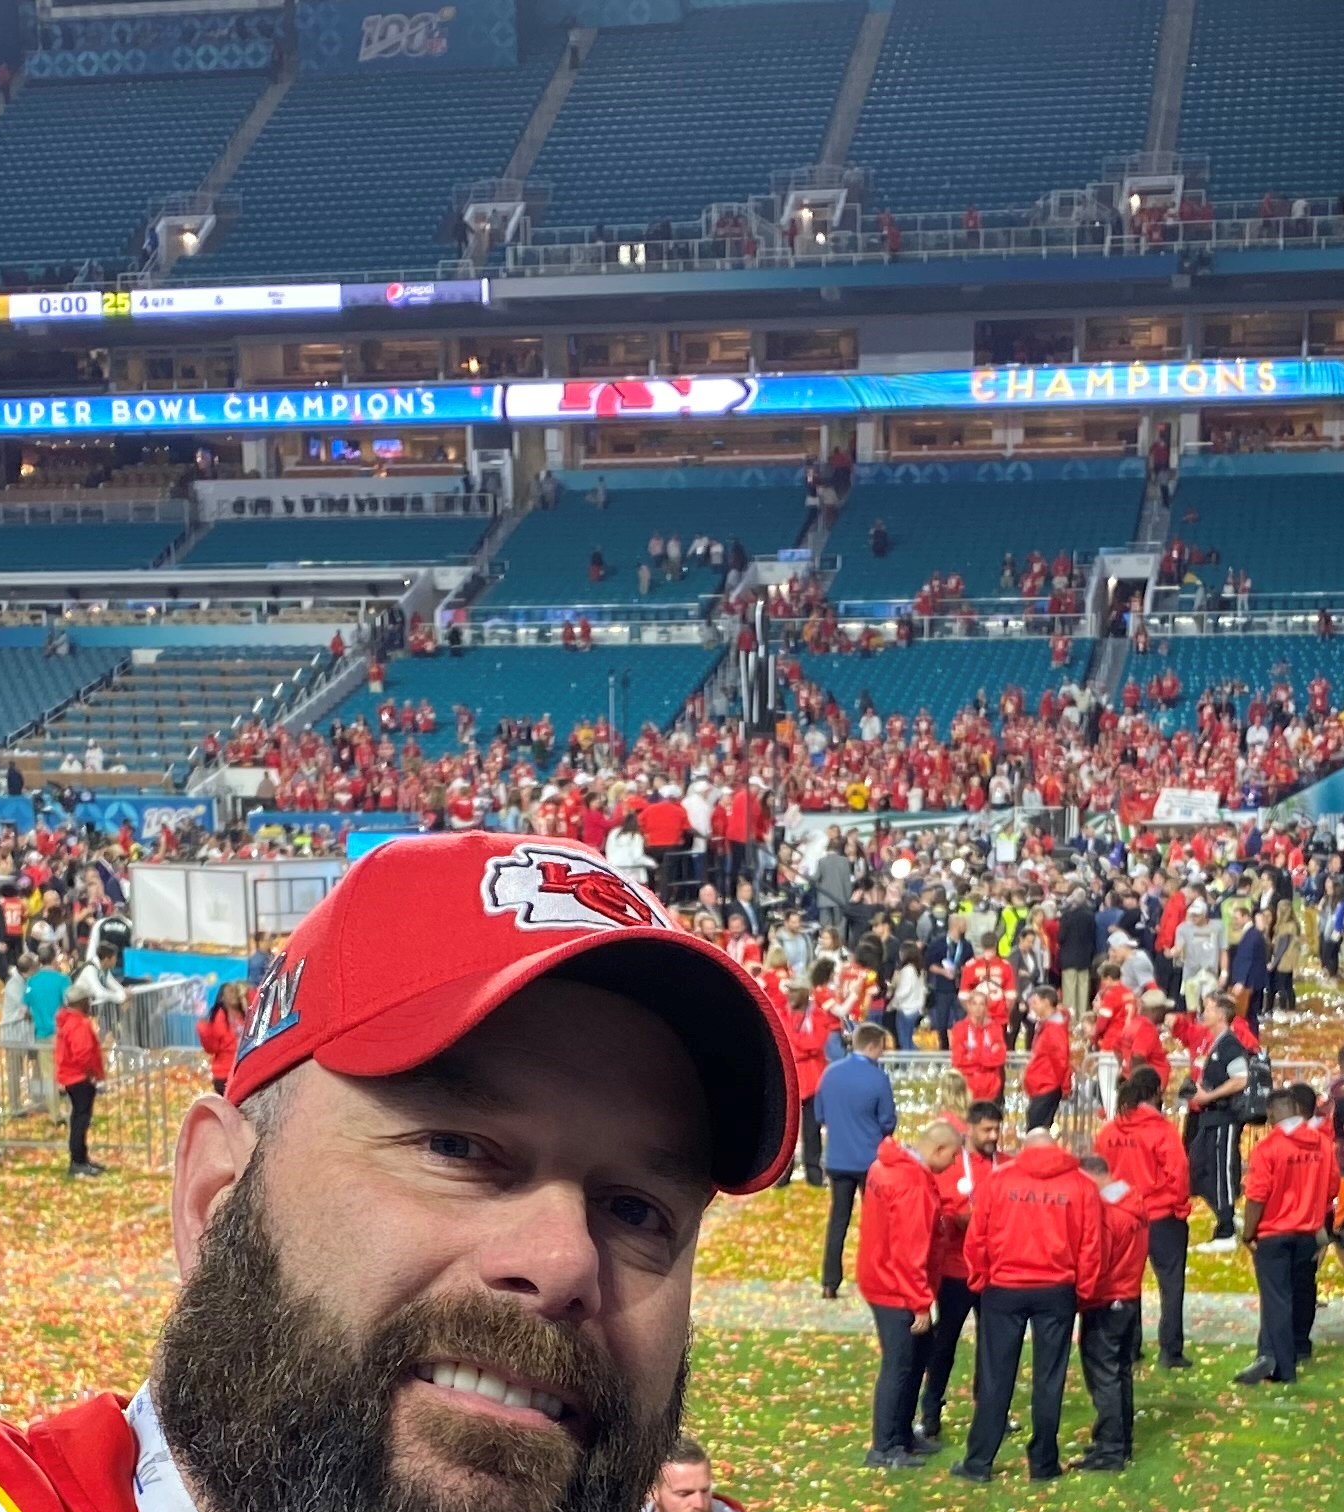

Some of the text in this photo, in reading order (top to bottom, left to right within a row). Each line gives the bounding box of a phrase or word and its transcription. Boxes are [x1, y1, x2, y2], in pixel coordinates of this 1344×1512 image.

[39, 296, 87, 314] 0:00
[103, 293, 131, 313] 25
[139, 296, 149, 309] 4
[971, 359, 1277, 398] CHAMPIONS
[112, 395, 205, 424] BOWL
[223, 390, 436, 421] CHAMPIONS
